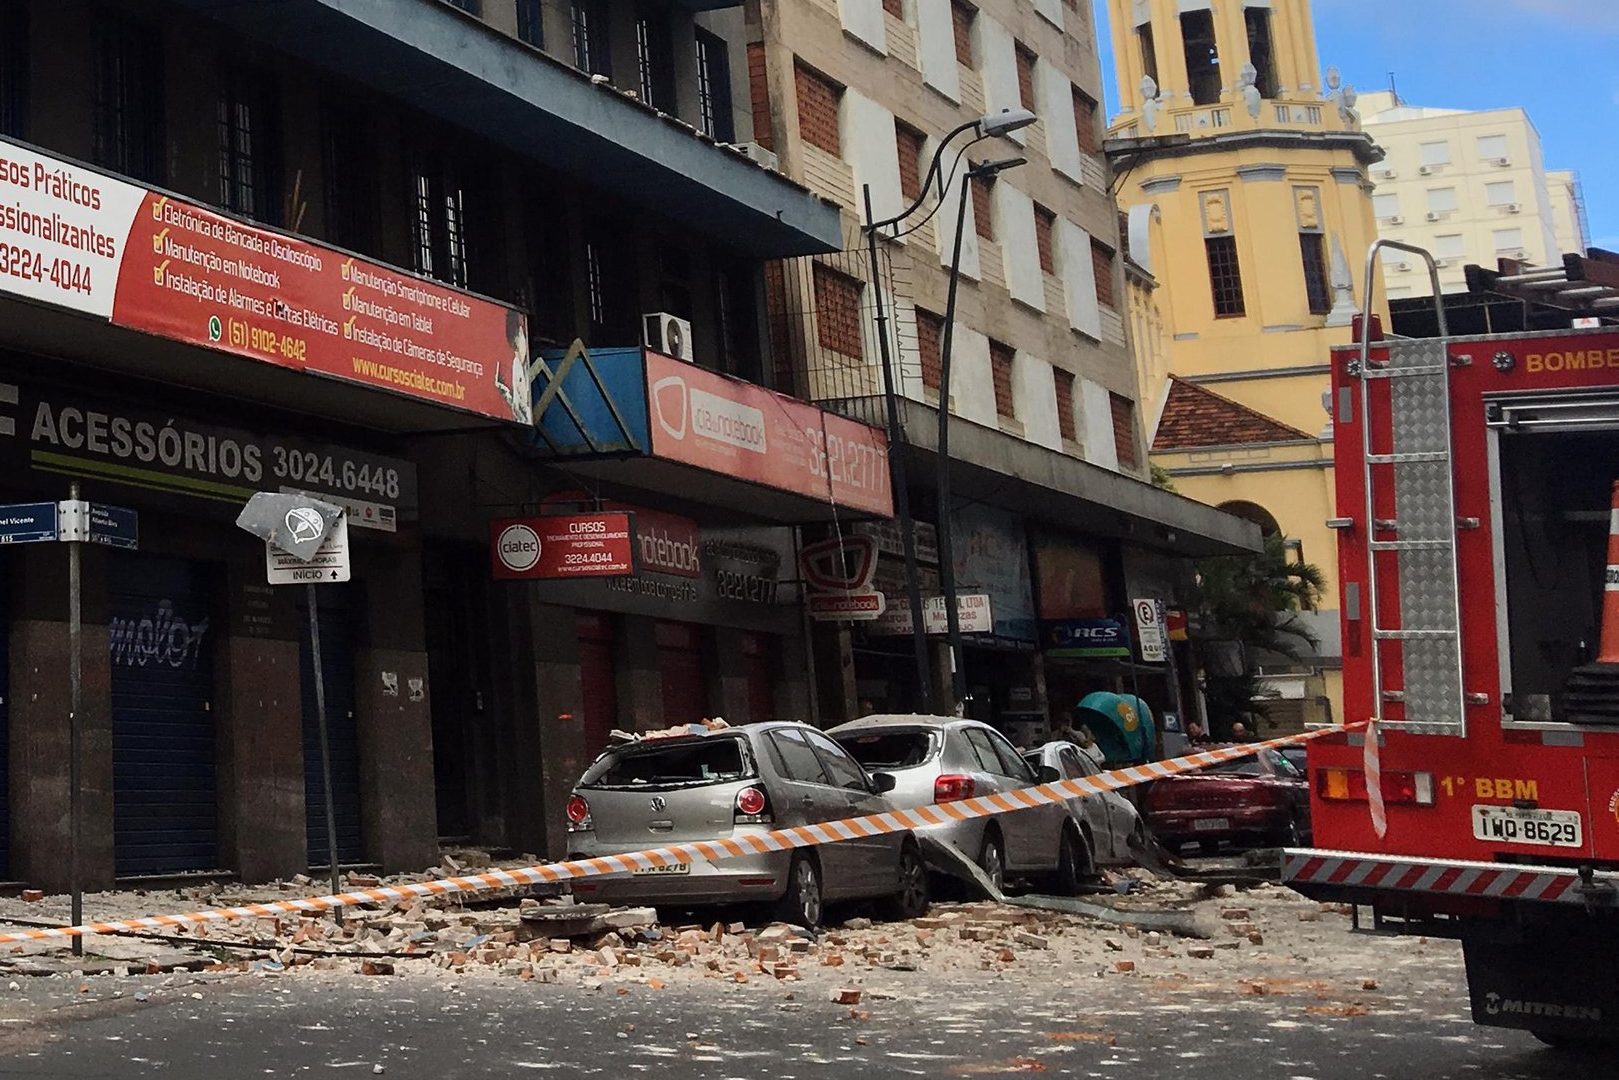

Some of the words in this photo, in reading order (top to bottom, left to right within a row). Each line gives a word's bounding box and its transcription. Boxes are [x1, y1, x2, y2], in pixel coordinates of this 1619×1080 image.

[34, 162, 101, 211] Práticos
[164, 205, 211, 234] Eletrônica
[212, 222, 224, 239] de
[225, 225, 263, 252] Bancada
[264, 242, 270, 255] e
[270, 241, 322, 272] Osciloscópio
[165, 237, 222, 273] Manutenção
[223, 259, 238, 277] em
[238, 260, 281, 289] Notebook
[166, 269, 214, 302] Instalação
[215, 285, 227, 304] de
[228, 288, 265, 314] Alarmes
[266, 302, 272, 315] e
[303, 309, 339, 336] Elétricas
[350, 265, 397, 297] Manutenção
[397, 281, 442, 310] Smartphone
[447, 296, 471, 319] Celular
[351, 295, 398, 326] Manutenção
[399, 312, 412, 329] em
[412, 312, 433, 335] Tablet
[228, 317, 249, 350] (51)
[251, 327, 307, 361] 9102-4642
[353, 324, 391, 352] Instalação
[392, 337, 403, 354] de
[403, 338, 436, 362] Câmeras
[436, 349, 446, 366] de
[446, 350, 483, 379] Segurança
[352, 357, 466, 400] www.cursosciatec.com.br
[31, 401, 263, 483] ACESSÓRIOS
[272, 447, 400, 499] 3024.6448
[9, 517, 35, 525] Vicente
[569, 522, 606, 533] CURSOS
[502, 540, 536, 553] ciatec
[564, 552, 613, 565] 3224.4044
[293, 570, 323, 580] INÍCIO
[1165, 715, 1176, 728] P
[1476, 777, 1538, 800] BBM
